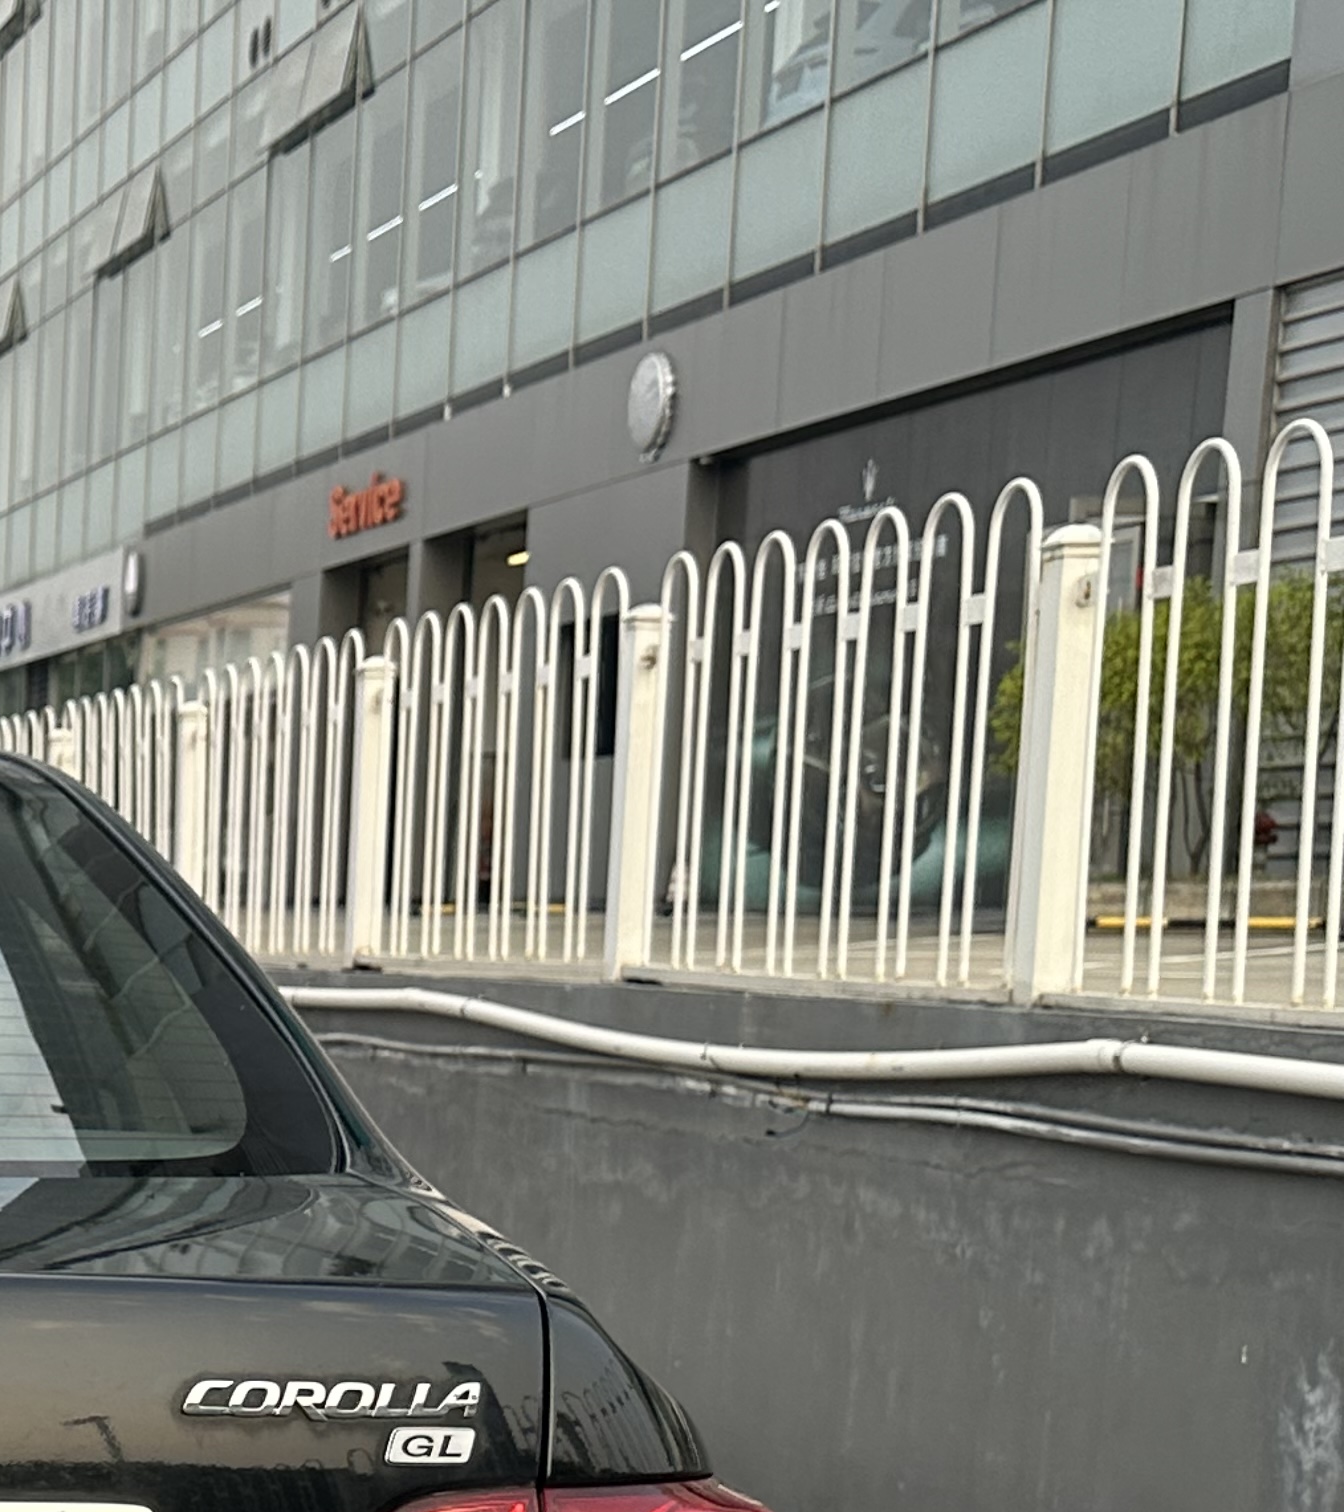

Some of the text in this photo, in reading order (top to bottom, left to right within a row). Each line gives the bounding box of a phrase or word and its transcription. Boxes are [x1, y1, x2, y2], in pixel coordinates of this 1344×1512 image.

[328, 472, 403, 538] Service
[181, 1379, 481, 1422] COROLLA
[401, 1434, 463, 1459] GL
